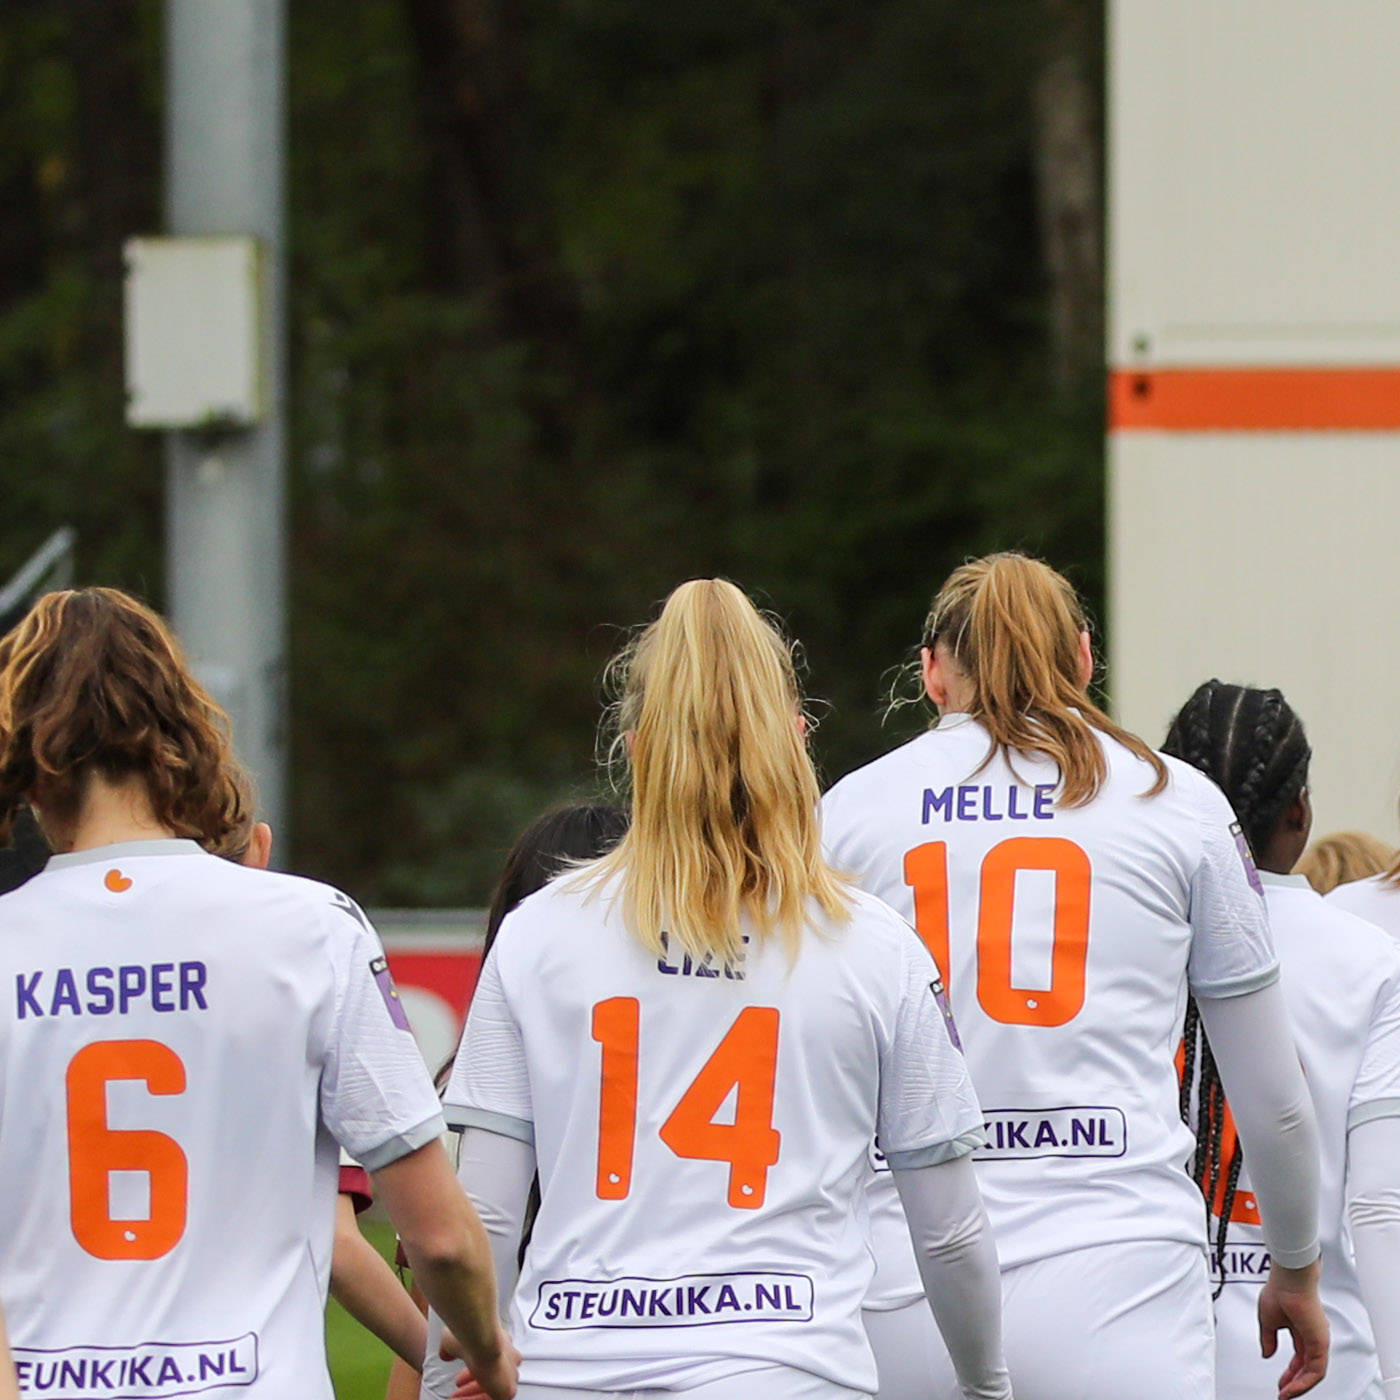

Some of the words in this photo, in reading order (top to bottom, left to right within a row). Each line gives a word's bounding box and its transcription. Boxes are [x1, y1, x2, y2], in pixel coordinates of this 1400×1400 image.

[921, 783, 1058, 825] MELLE
[16, 961, 208, 1020] KASPER
[903, 837, 1092, 1027] 10
[65, 1038, 188, 1261] 6
[591, 996, 781, 1209] 14
[545, 1283, 802, 1320] STEUNKIKA.NL
